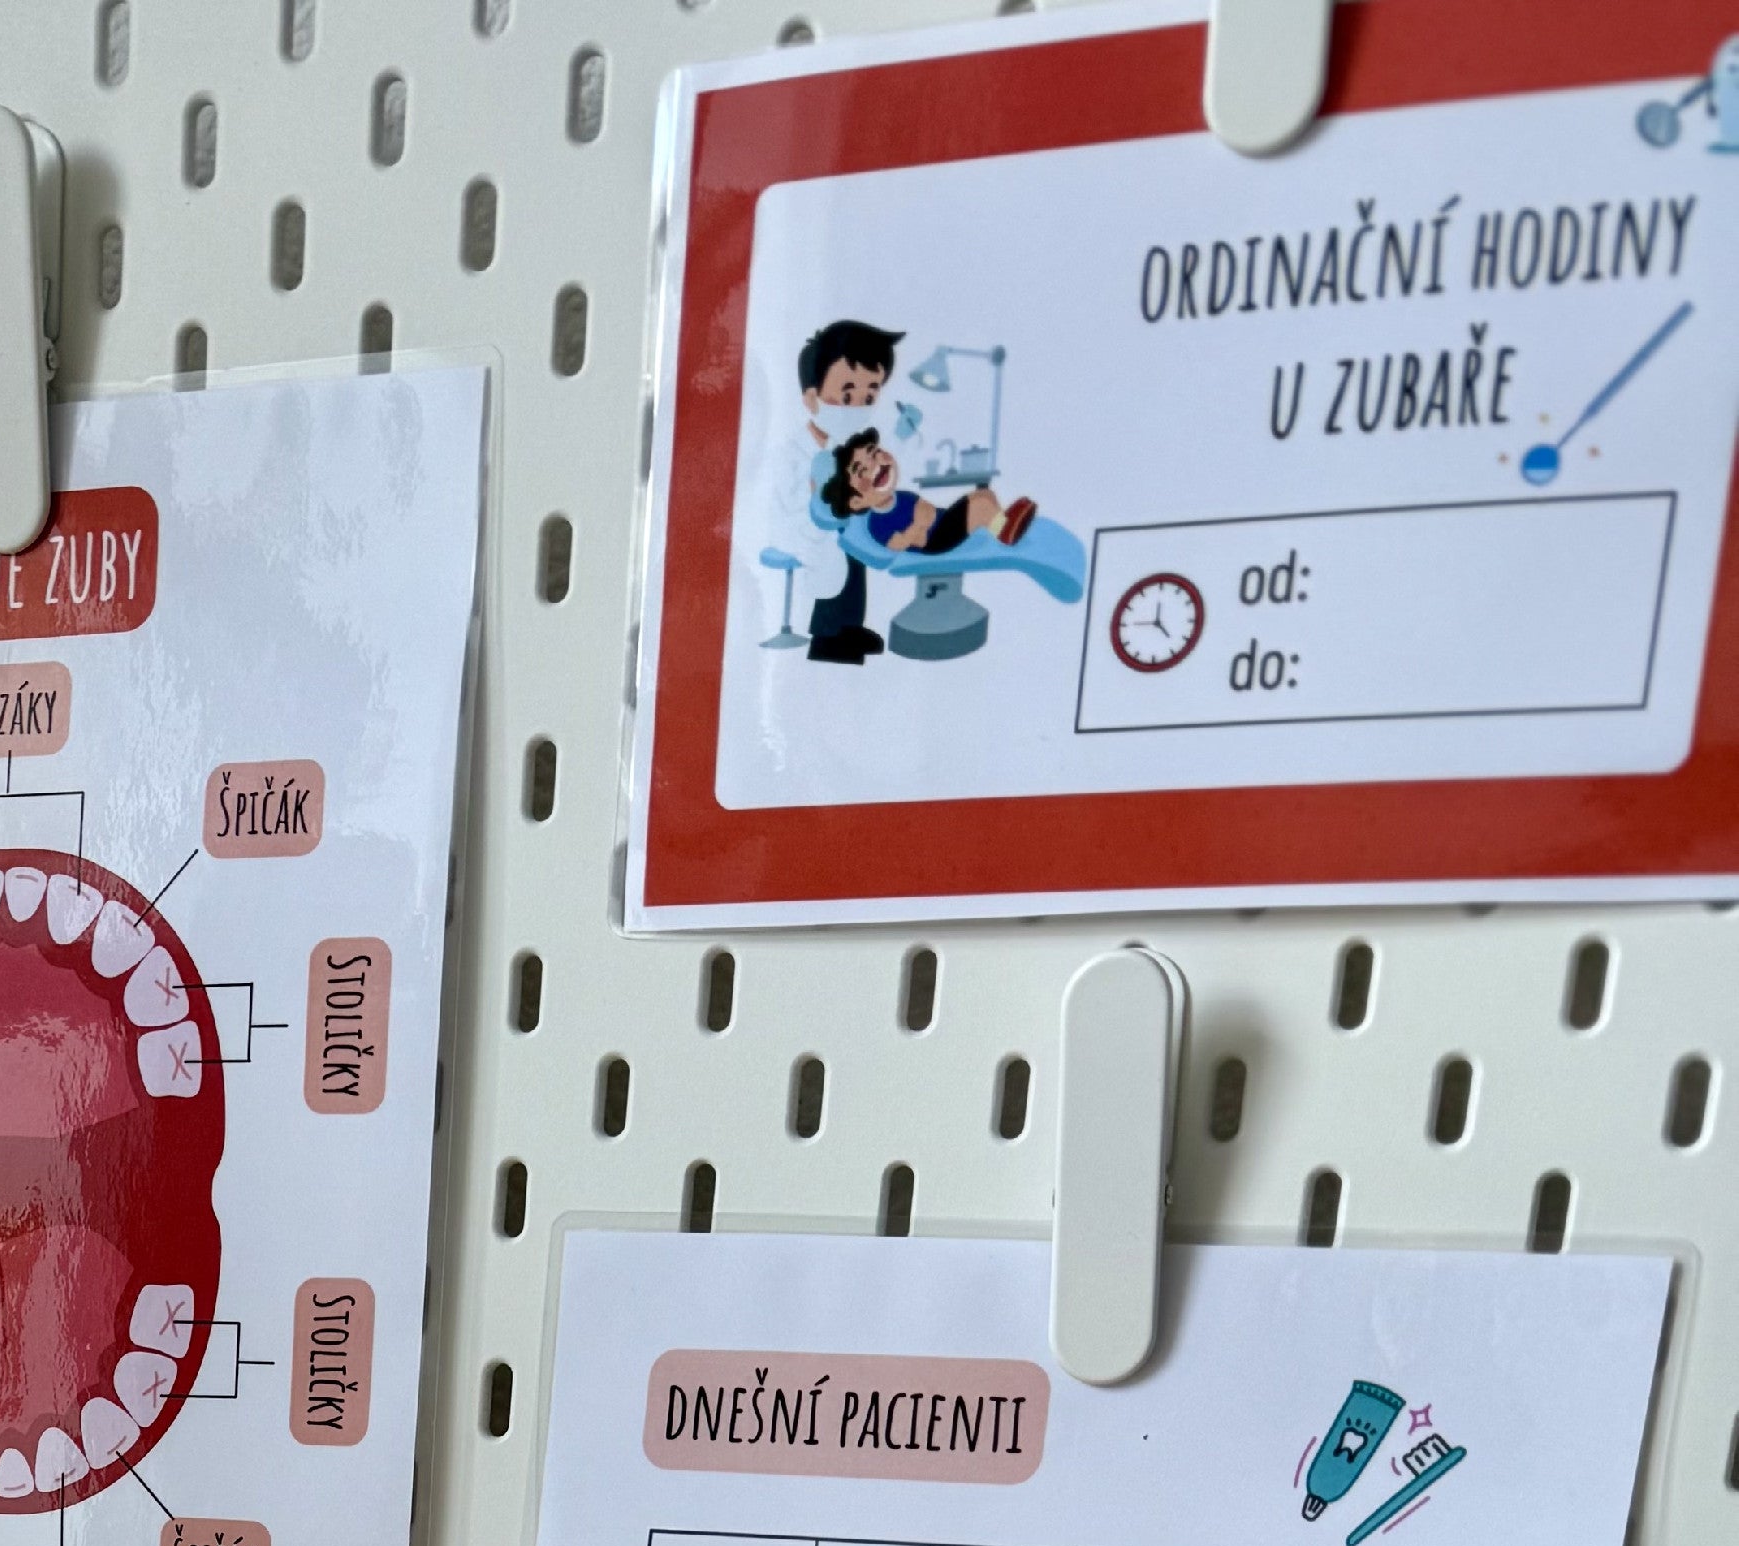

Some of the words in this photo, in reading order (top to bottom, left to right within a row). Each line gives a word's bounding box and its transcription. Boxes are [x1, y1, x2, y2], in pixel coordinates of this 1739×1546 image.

[1139, 193, 1462, 323] ORDINAČNÍ
[1469, 195, 1698, 292] HODINY
[1268, 361, 1305, 440] U
[1323, 322, 1517, 436] ZUBAŘE
[44, 527, 144, 607] ZUBY
[1237, 548, 1311, 606] od:
[1228, 637, 1301, 692] do:
[216, 770, 311, 839] ŠPIČÁK
[325, 953, 374, 1099] STOLIČKY
[307, 1293, 357, 1432] STOLIČKY
[665, 1367, 829, 1448] DNEŠNÍ
[839, 1389, 1027, 1455] PACIENTI
